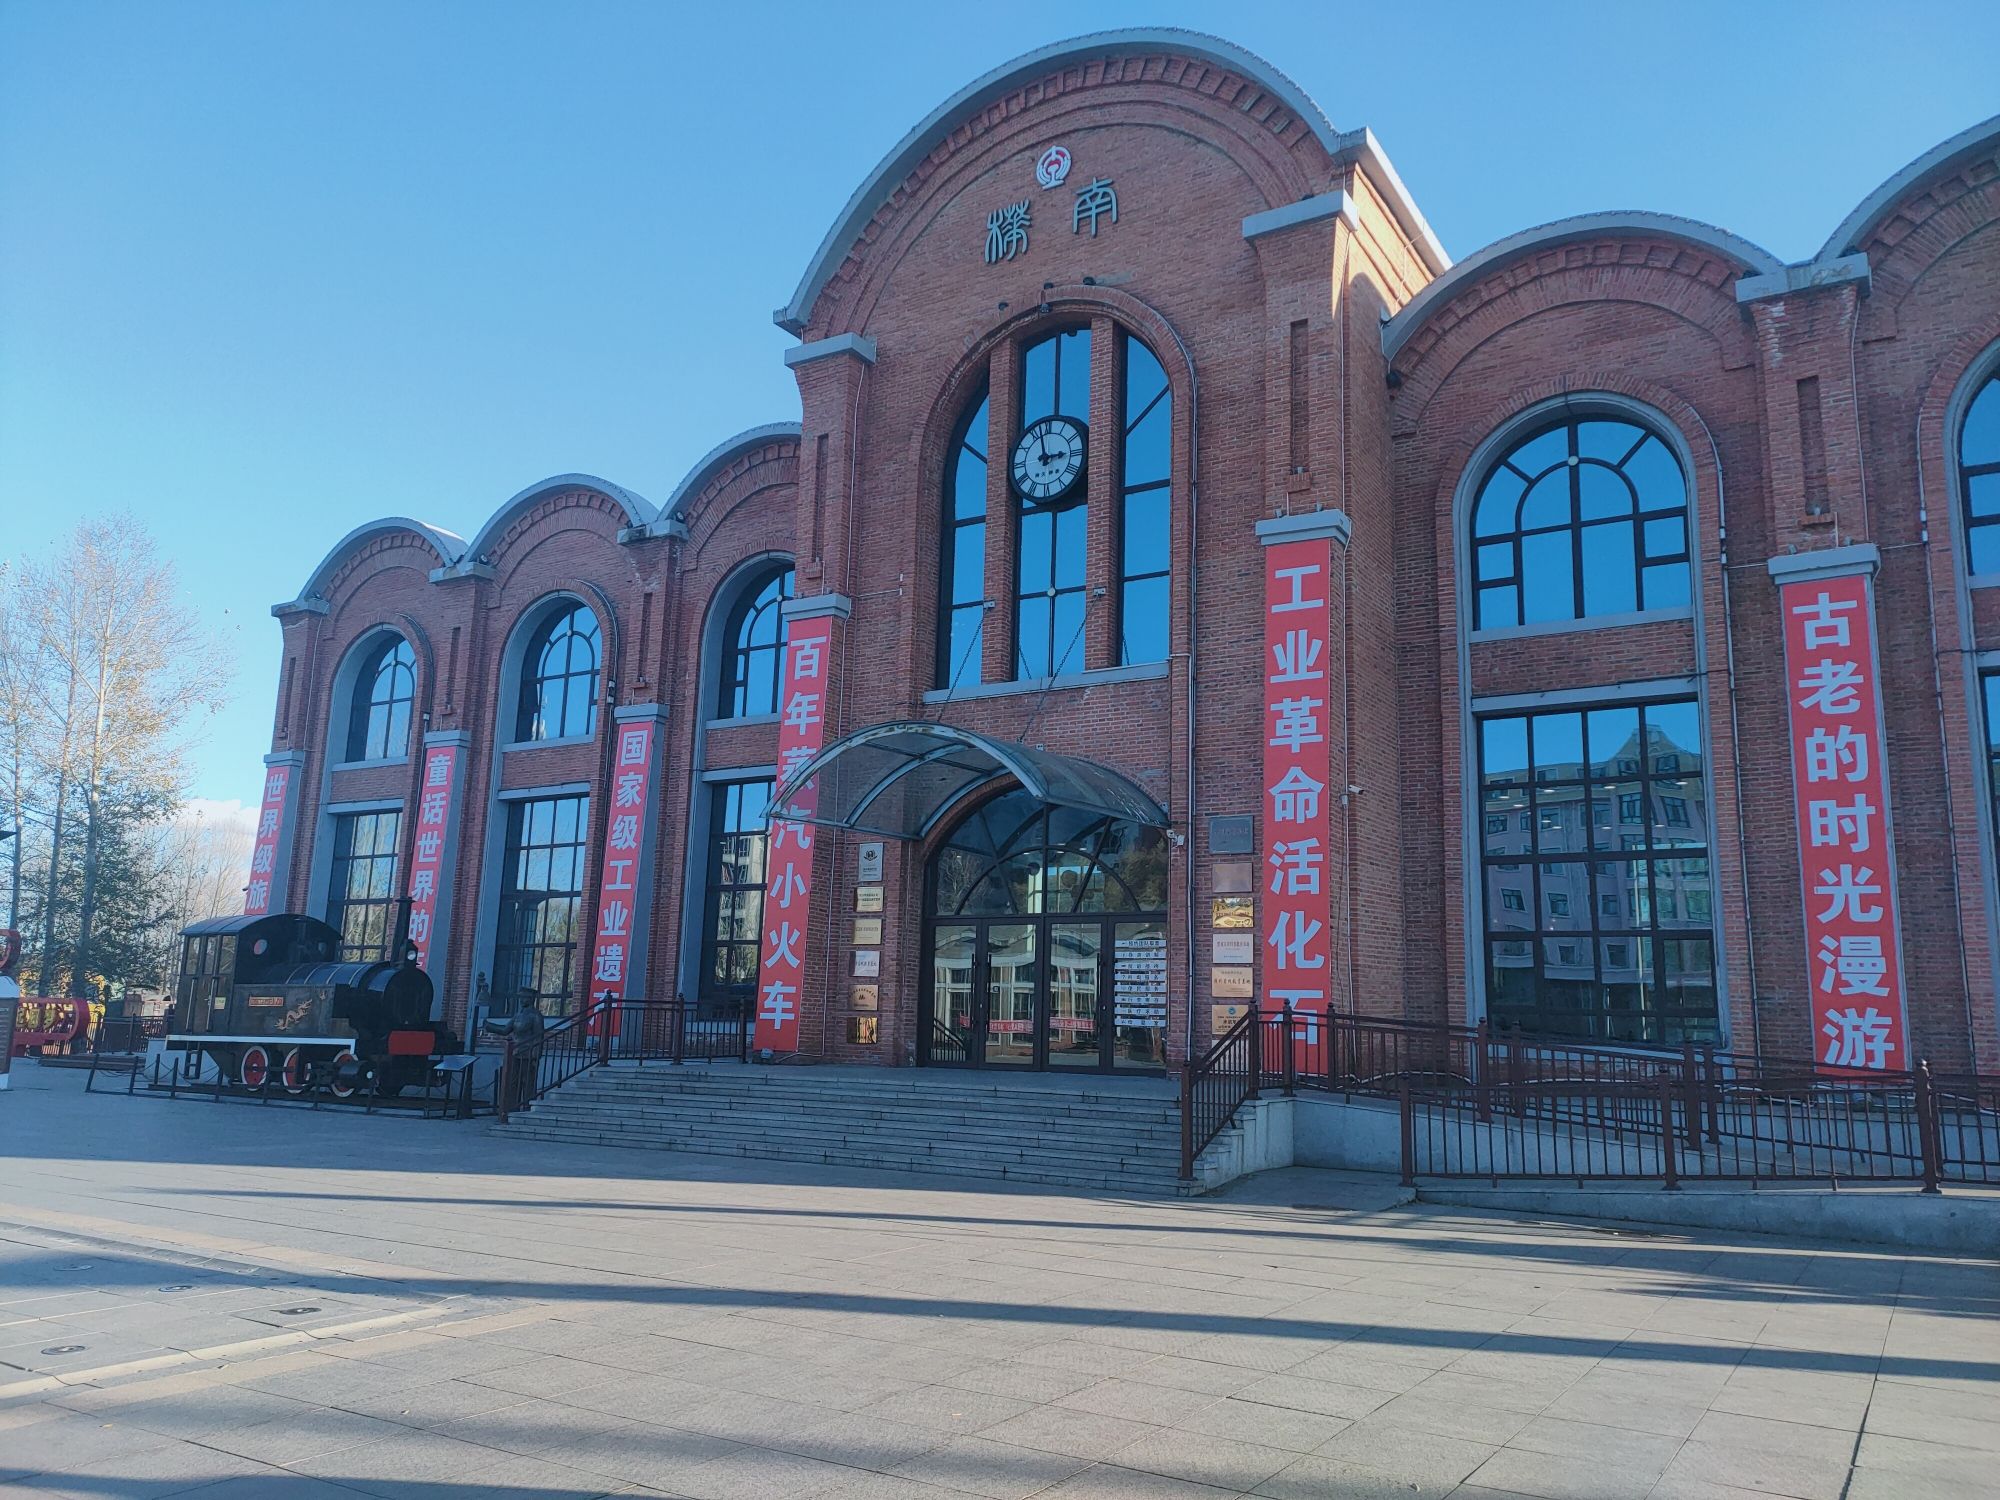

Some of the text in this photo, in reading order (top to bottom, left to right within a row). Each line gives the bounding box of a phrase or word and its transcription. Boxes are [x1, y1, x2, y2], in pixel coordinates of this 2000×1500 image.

[246, 773, 286, 910] 世界级旅
[408, 753, 457, 967] 童话世界的
[760, 636, 827, 1030] 百年蒸汽小火车
[1267, 564, 1326, 1045] 工业革命活化石
[1793, 592, 1896, 1069] 古老的时光漫游
